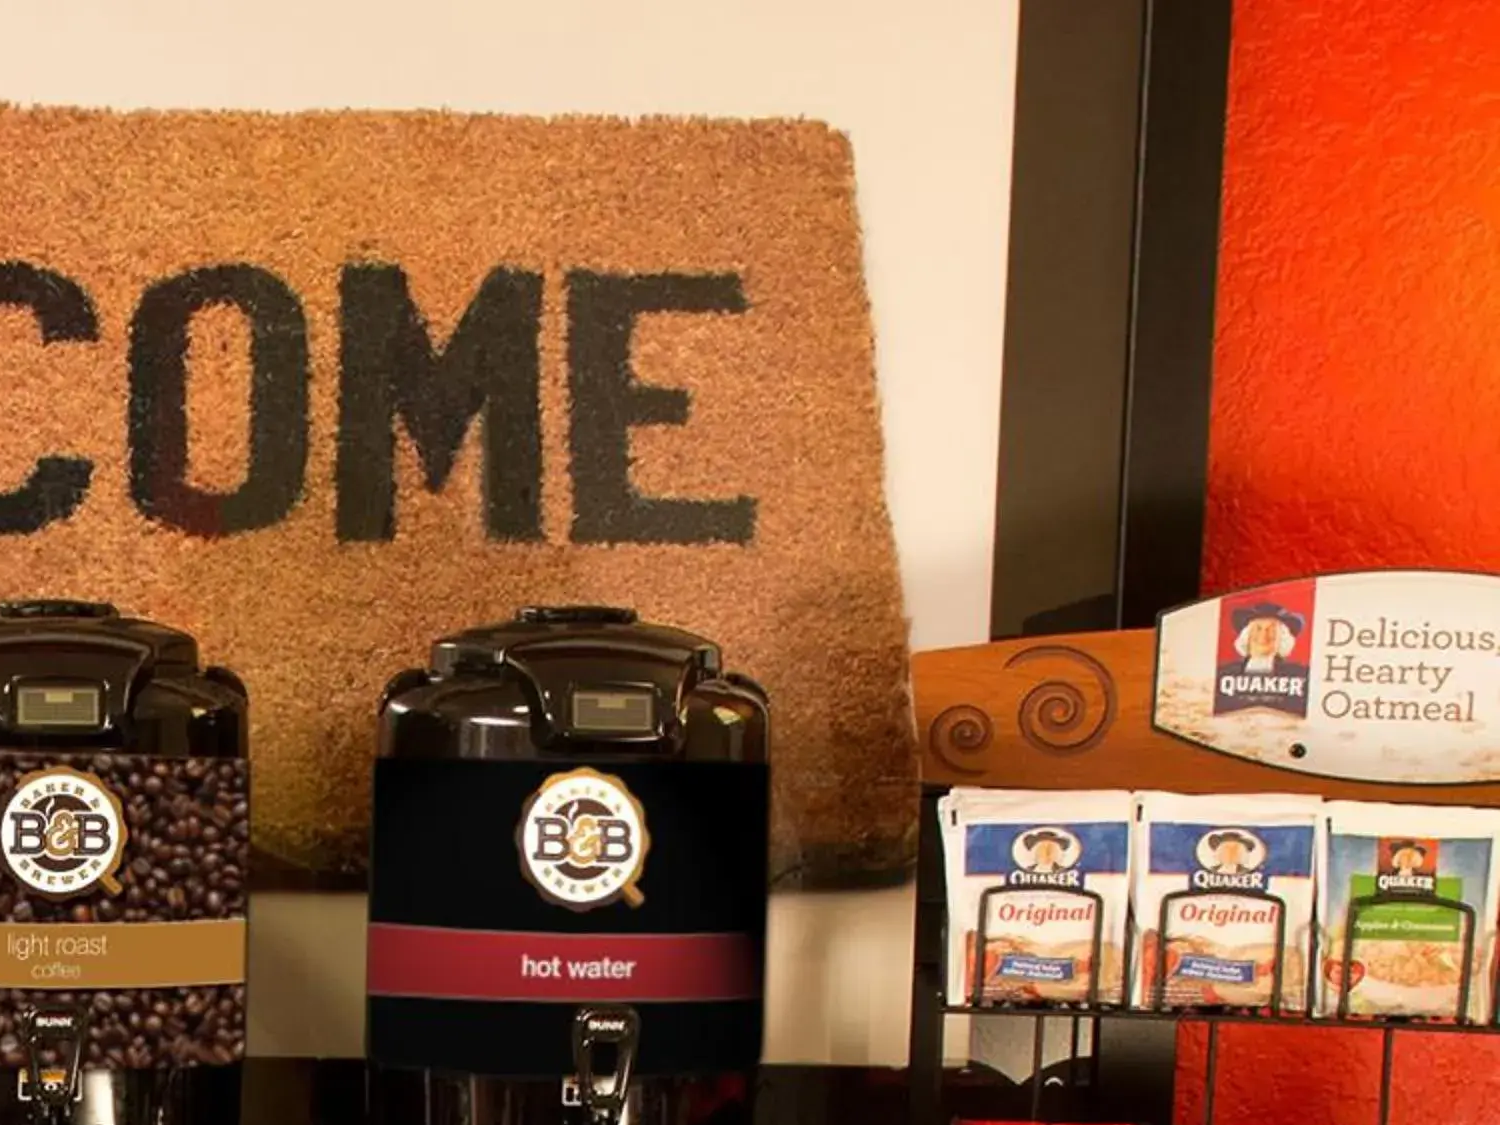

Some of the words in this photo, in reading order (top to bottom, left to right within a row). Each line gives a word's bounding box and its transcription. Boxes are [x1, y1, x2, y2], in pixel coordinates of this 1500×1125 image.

[1219, 675, 1304, 696] QUAKER
[1322, 655, 1455, 693] Hearty
[1321, 690, 1474, 723] Oatmeal
[9, 809, 112, 858] B&B
[533, 816, 634, 864] B&B
[19, 858, 102, 885] BREWER
[1193, 869, 1264, 889] QUAKER
[1378, 874, 1435, 891] QUAKER
[998, 902, 1094, 927] Original
[1180, 903, 1277, 928] Original
[7, 932, 50, 961] light
[55, 934, 108, 956] roast
[31, 961, 82, 980] coffee
[521, 953, 562, 979] hot
[567, 956, 638, 980] water
